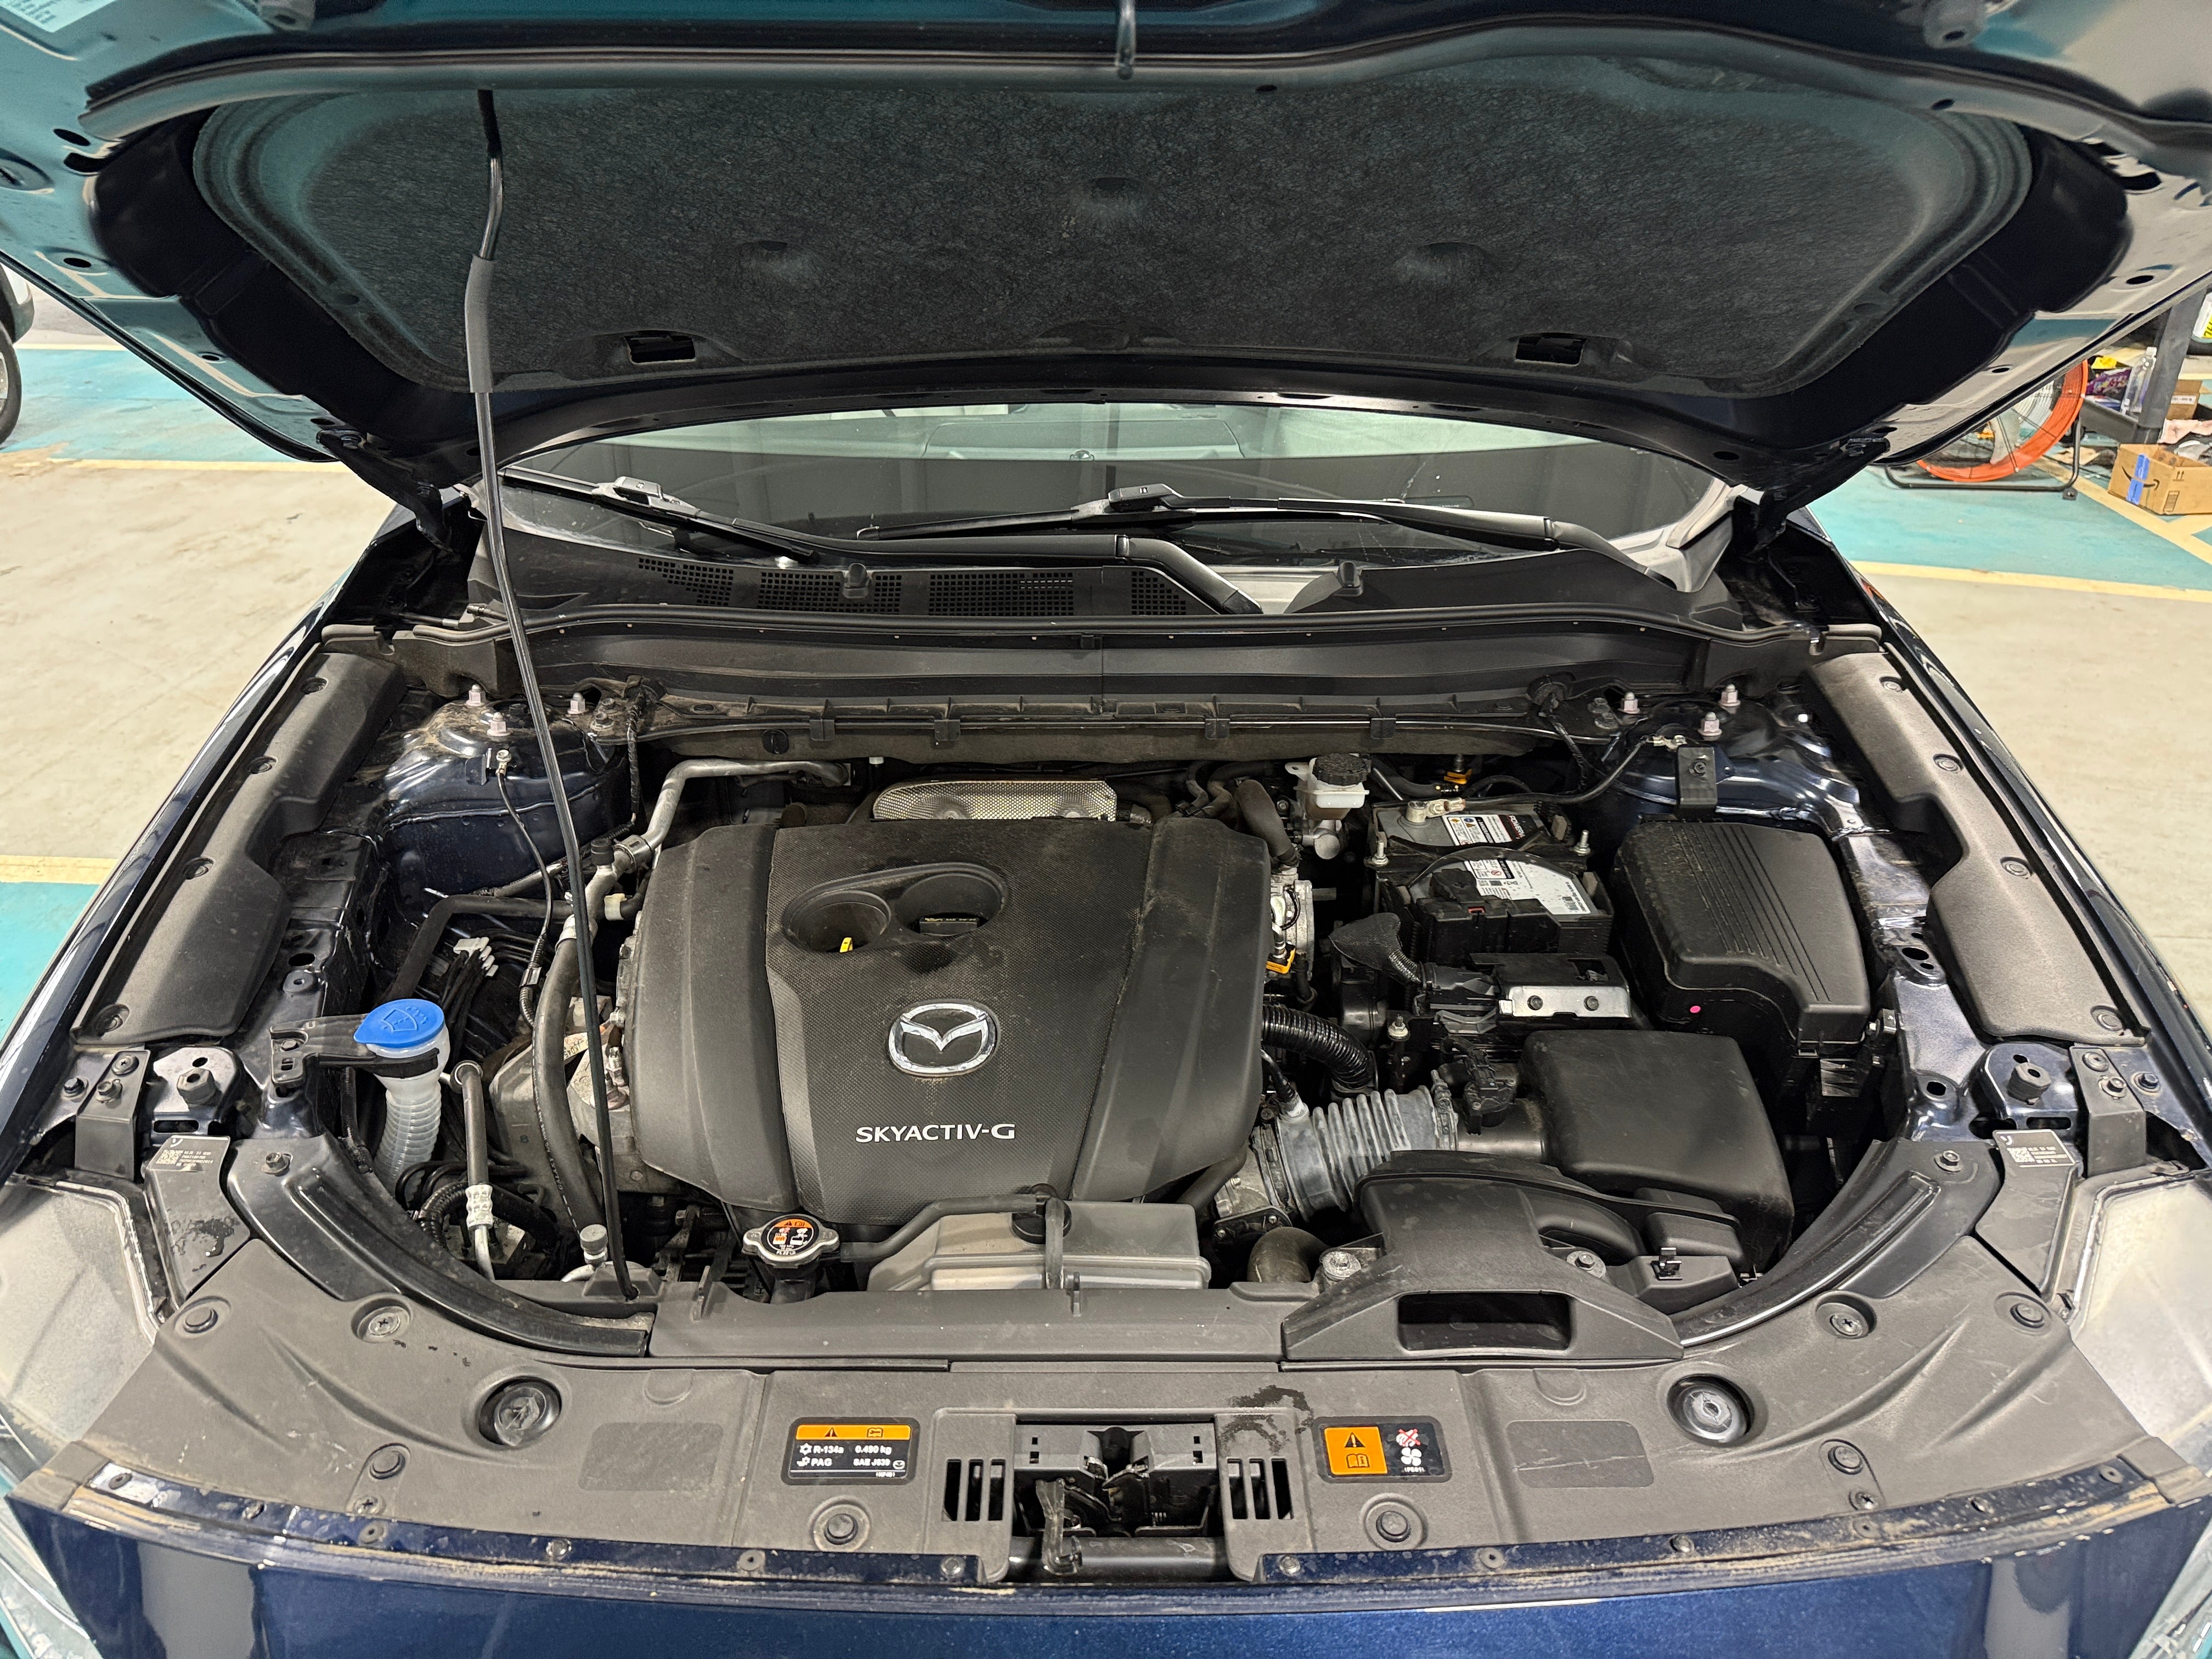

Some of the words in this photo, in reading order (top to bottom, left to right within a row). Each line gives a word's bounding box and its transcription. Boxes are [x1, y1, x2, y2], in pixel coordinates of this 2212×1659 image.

[856, 1124, 1015, 1143] SKYACTIV-G
[813, 1445, 844, 1454] R-134a
[880, 1444, 892, 1455] kg
[810, 1458, 832, 1467] PAG
[853, 1458, 871, 1466] SAE
